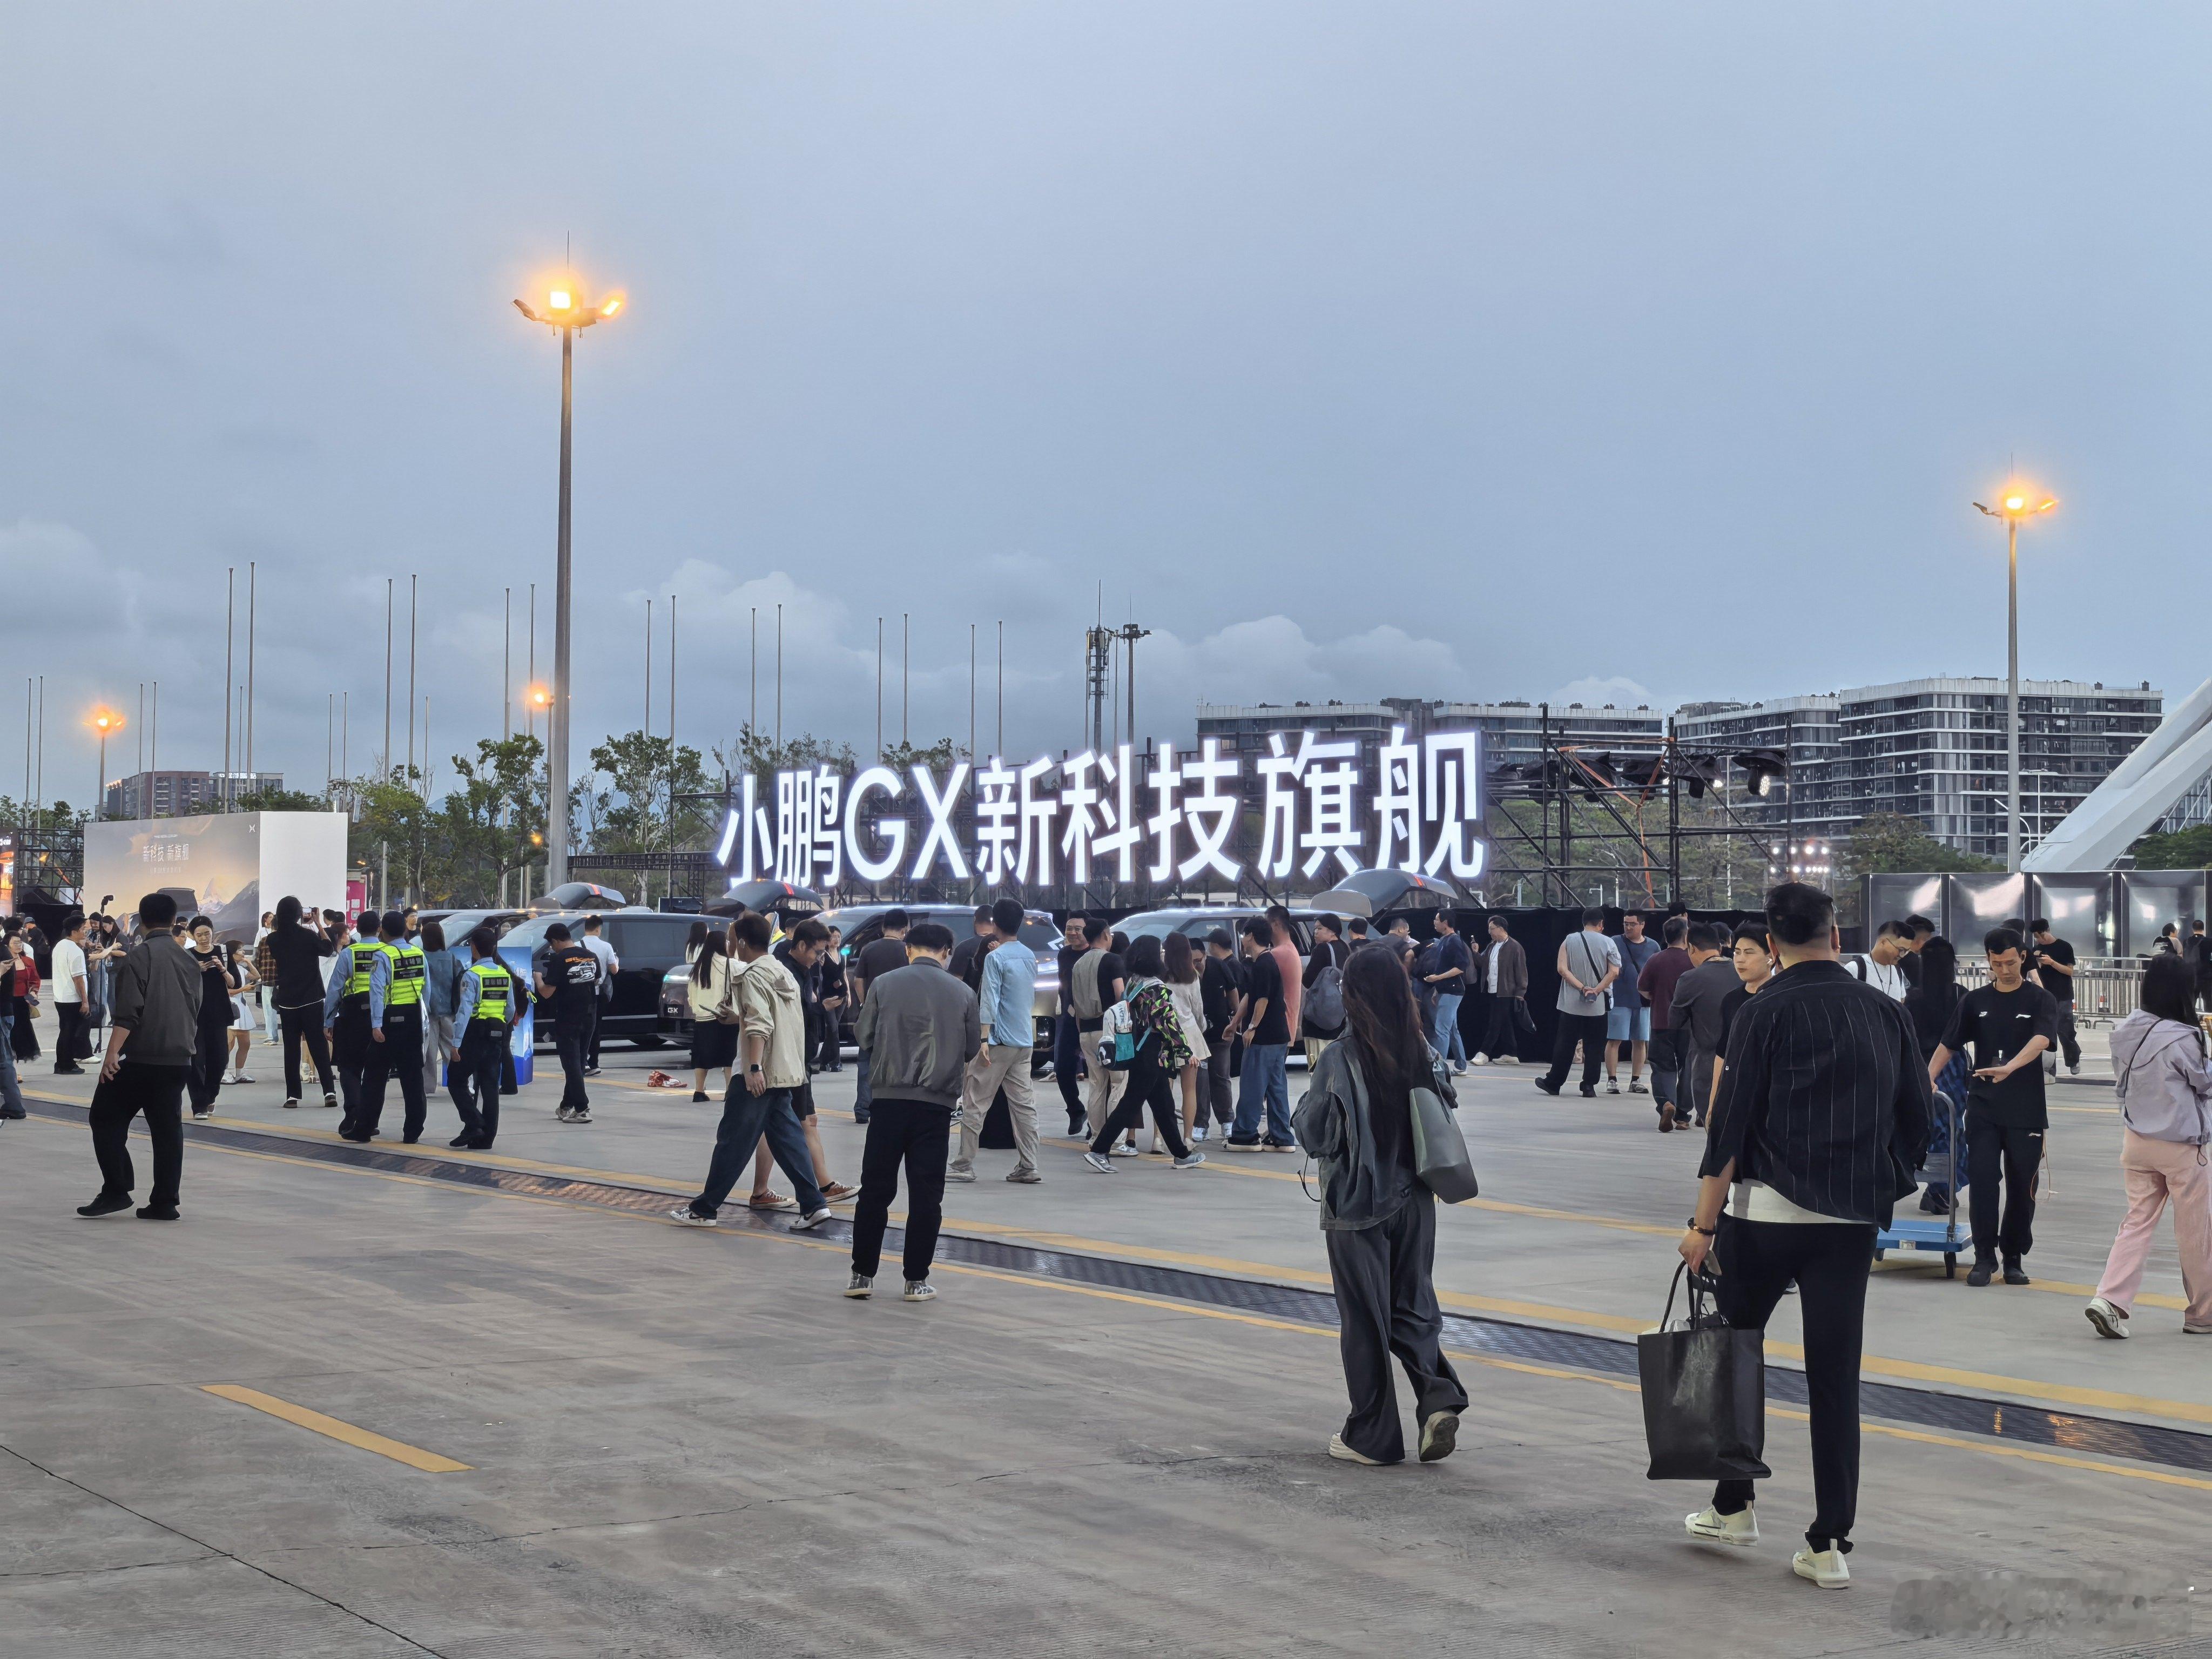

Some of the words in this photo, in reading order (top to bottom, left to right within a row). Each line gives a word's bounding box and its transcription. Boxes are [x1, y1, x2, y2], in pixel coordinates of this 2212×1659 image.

[717, 726, 1483, 888] 小鹏GX新科技旗舰
